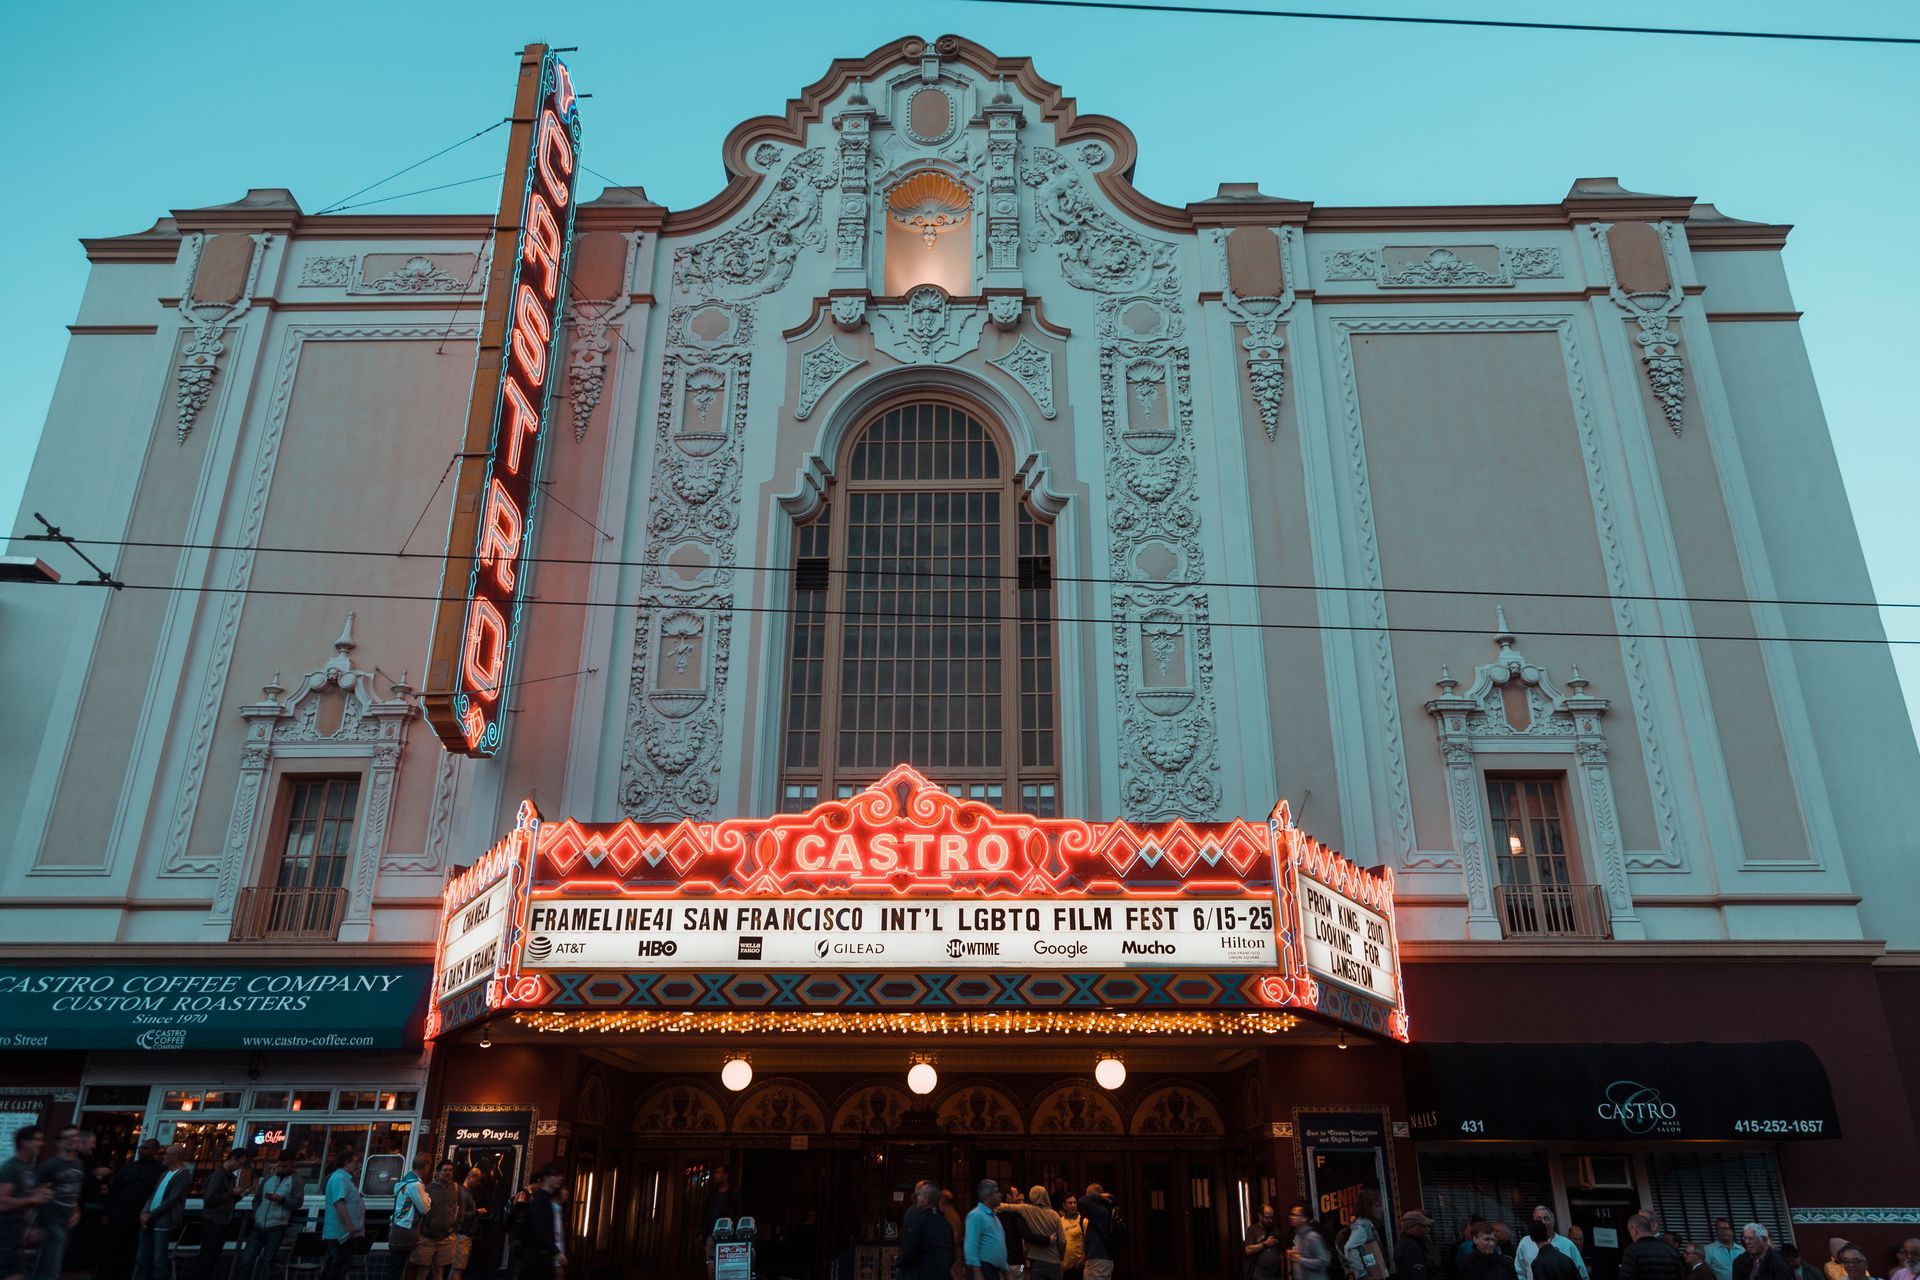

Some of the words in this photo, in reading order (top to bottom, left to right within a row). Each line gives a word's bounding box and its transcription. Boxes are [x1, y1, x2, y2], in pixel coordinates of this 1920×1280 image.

[466, 110, 572, 701] CASTRO
[795, 833, 1010, 871] CASTRO
[462, 898, 492, 934] CHAVELA
[531, 907, 673, 931] FRAMELINE41
[683, 907, 728, 931] SAN
[736, 907, 863, 931] FRANCISCO
[880, 907, 943, 931] INT'L
[958, 907, 1040, 932] LGBTQ
[1054, 907, 1113, 931] FILM
[1126, 907, 1179, 931] FEST
[1193, 906, 1273, 931] 6/15-25
[1307, 888, 1333, 919] PROM
[1366, 919, 1384, 945] 2010
[556, 943, 586, 954] AT&T
[638, 940, 677, 956] HBO
[834, 943, 885, 954] GILEAD
[1034, 940, 1088, 958] Google
[1122, 940, 1176, 955] Mucho
[1221, 936, 1265, 948] Hilton
[1314, 917, 1353, 955] LOOKING
[1363, 941, 1381, 967] FOR
[448, 963, 464, 990] DAYS
[472, 941, 498, 976] FRANCE
[1330, 951, 1374, 989] LANGSTON
[0, 976, 114, 993] CASTRO
[122, 976, 241, 993] COFFEE
[247, 975, 403, 992] COMPANY
[52, 996, 168, 1011] CUSTOM
[172, 996, 310, 1011] ROASTERS
[132, 1013, 173, 1024] Since
[177, 1013, 208, 1024] 1970
[13, 1033, 48, 1046] Street
[243, 1034, 374, 1046] www.castro-coffee.com
[1597, 1103, 1676, 1119] CASTRO
[1410, 1111, 1437, 1128] NAILS
[1461, 1119, 1484, 1133] 431
[1734, 1119, 1824, 1133] 415-252-1657
[456, 1128, 480, 1140] Now
[482, 1128, 520, 1140] Playing
